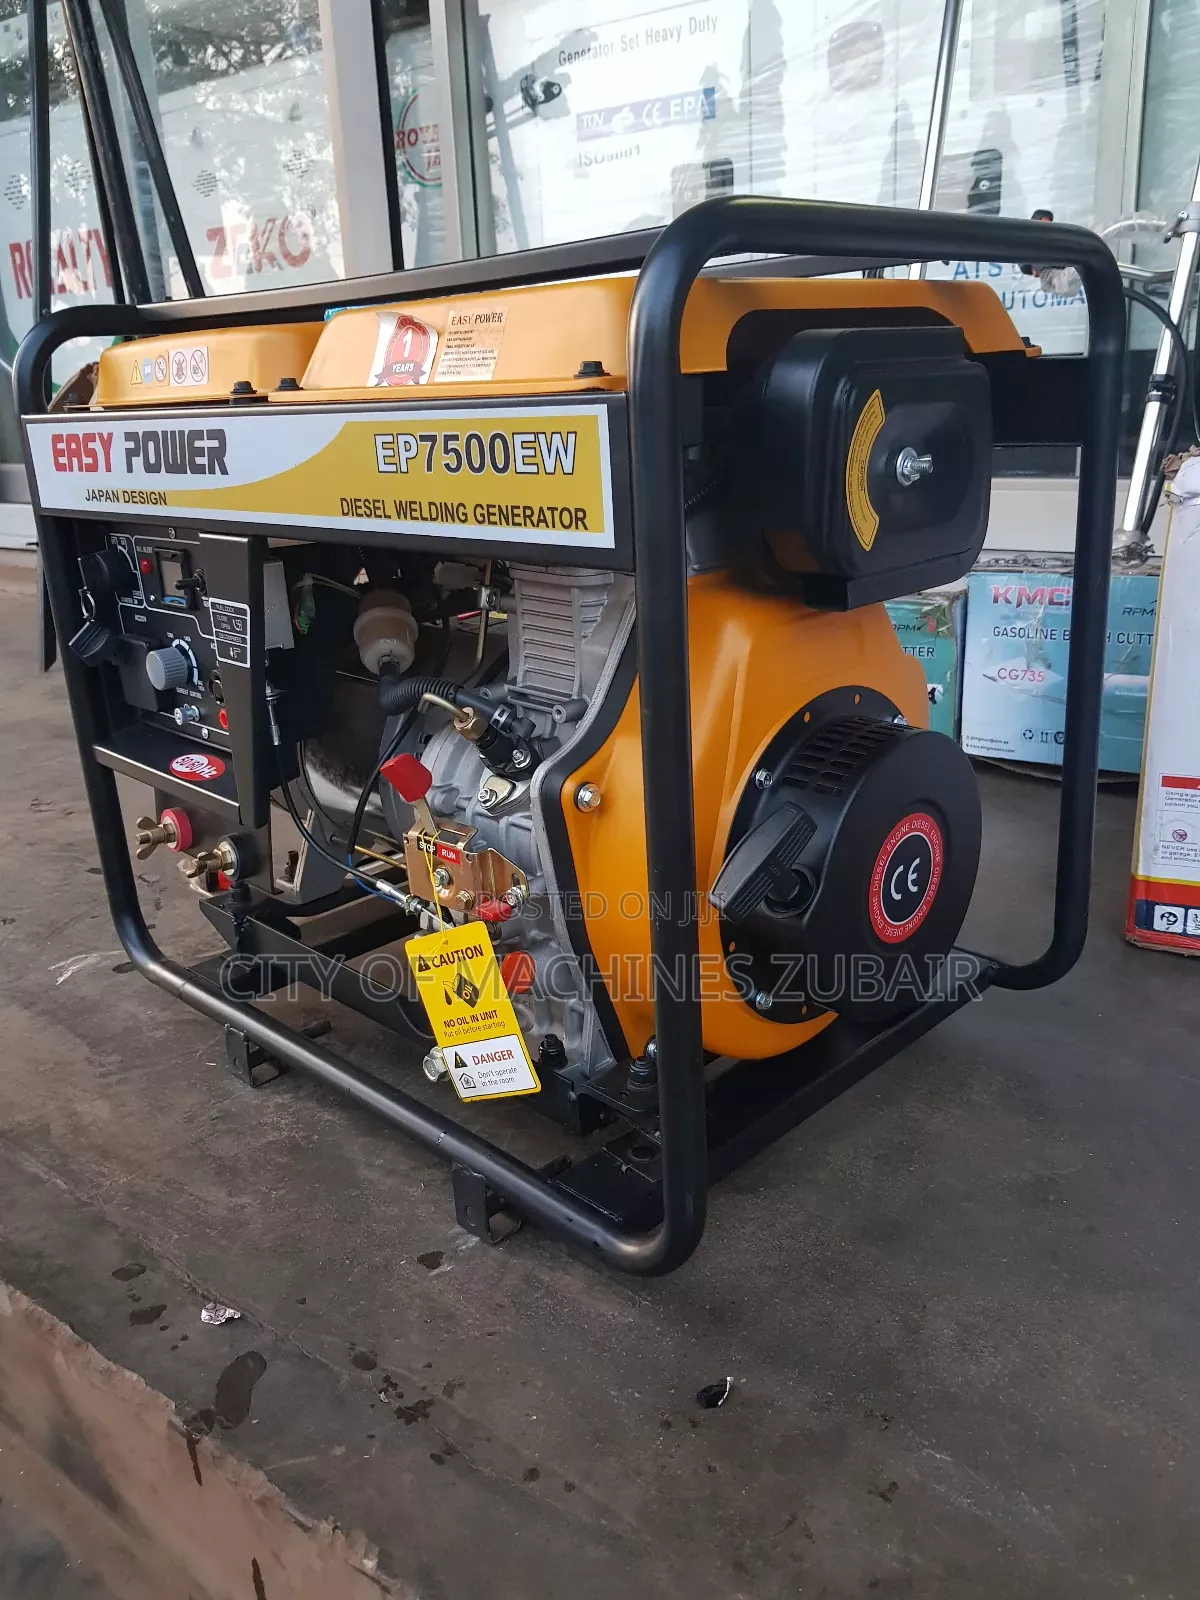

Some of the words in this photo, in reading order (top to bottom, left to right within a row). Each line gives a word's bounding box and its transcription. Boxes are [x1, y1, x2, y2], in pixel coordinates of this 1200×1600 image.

[558, 43, 614, 66] Generator
[621, 33, 640, 52] Set
[646, 25, 682, 46] Heavy
[689, 15, 718, 36] Duty
[670, 94, 710, 120] EPA
[451, 313, 474, 326] EASY
[475, 312, 503, 324] POWER
[402, 329, 413, 357] 1
[392, 363, 414, 373] YEARS
[51, 431, 113, 473] EASY
[124, 429, 229, 475] POWER
[374, 431, 577, 475] EP7500EW
[85, 489, 119, 504] JAPAN
[122, 490, 167, 506] DESIGN
[340, 497, 391, 520] DIESEL
[394, 500, 468, 524] WELDING
[473, 503, 588, 531] GENERATOR
[993, 626, 1058, 640] GASOLINE
[997, 667, 1046, 683] CG735
[911, 820, 932, 833] DIESEL
[887, 823, 910, 851] ENGINE
[930, 829, 940, 863] ENGINE
[420, 841, 436, 853] STOP
[441, 849, 456, 860] RUN
[872, 854, 888, 891] DIESEL
[925, 867, 940, 901] DIESEL
[872, 897, 885, 929] ENGINE
[905, 904, 927, 932] ENGINE
[884, 925, 903, 937] DIESEL
[432, 944, 484, 968] CAUTION
[463, 984, 474, 1000] OIL
[443, 1018, 455, 1029] NO
[457, 1015, 469, 1026] OIL
[471, 1014, 479, 1024] IN
[481, 1009, 498, 1021] UNIT
[444, 1030, 454, 1038] Put
[462, 1023, 482, 1035] before
[482, 1020, 506, 1032] starting
[471, 1049, 515, 1066] DANGER
[478, 1069, 494, 1079] Don't
[495, 1067, 518, 1078] operate
[488, 1079, 498, 1087] the
[499, 1077, 515, 1085] room
